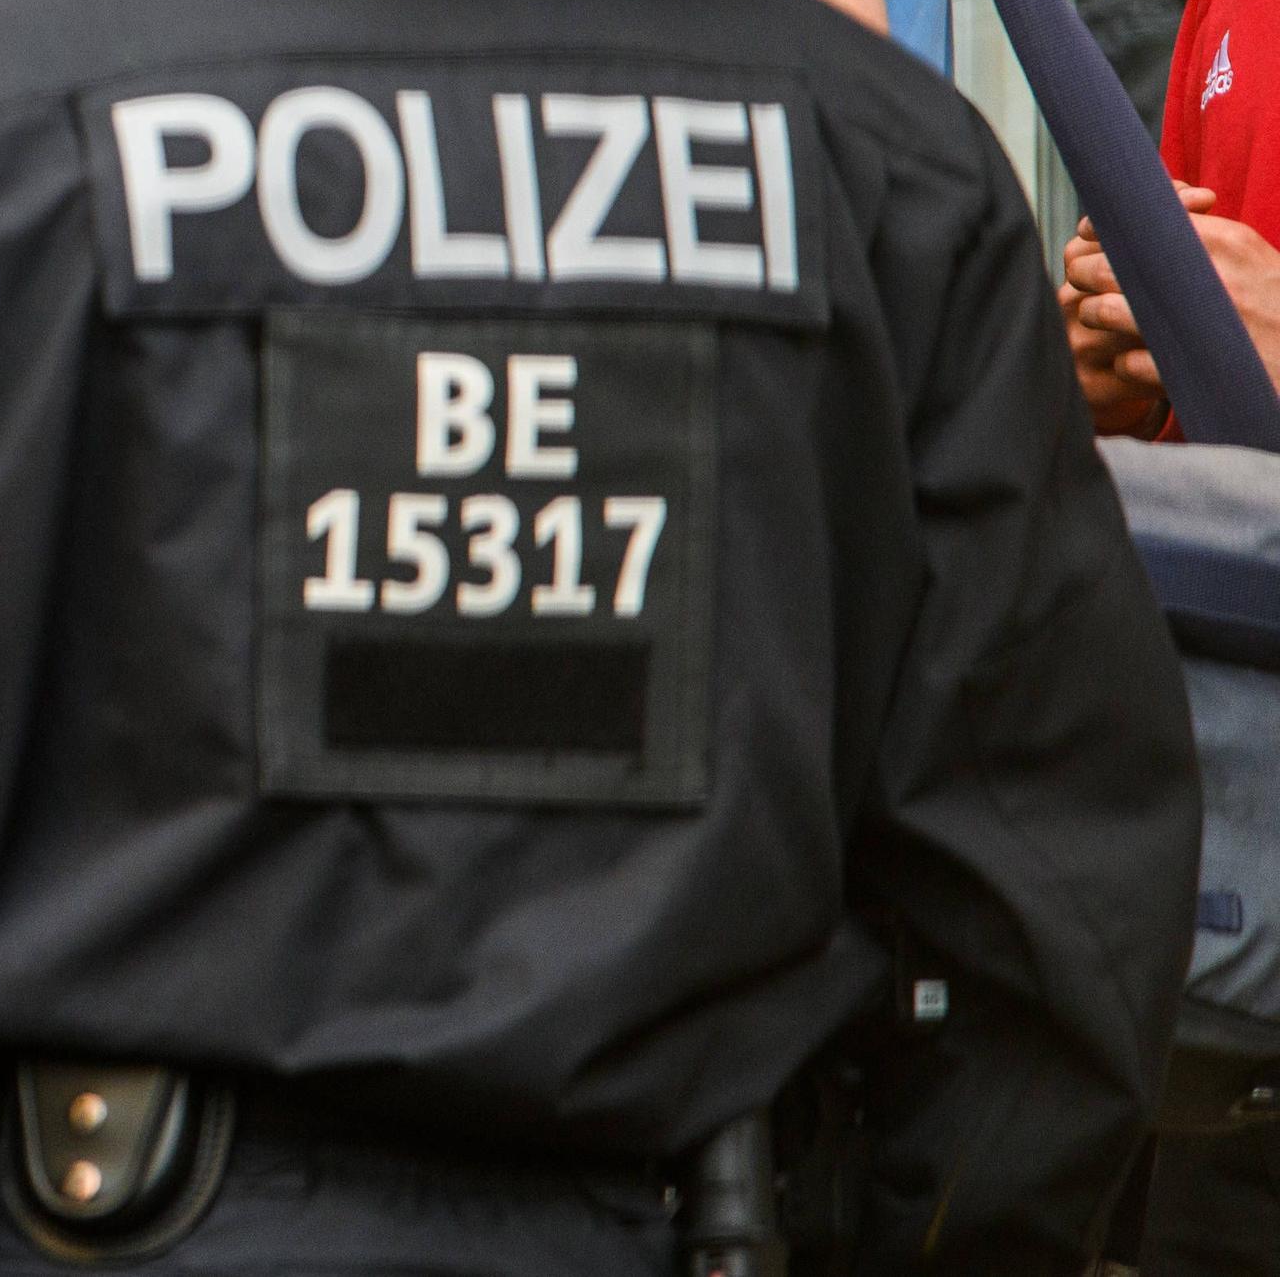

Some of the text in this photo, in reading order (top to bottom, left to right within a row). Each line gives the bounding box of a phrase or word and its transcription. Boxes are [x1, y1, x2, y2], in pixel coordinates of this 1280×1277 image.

[111, 86, 797, 289] POLIZEI
[417, 352, 577, 477] BE
[304, 489, 667, 616] 15317
